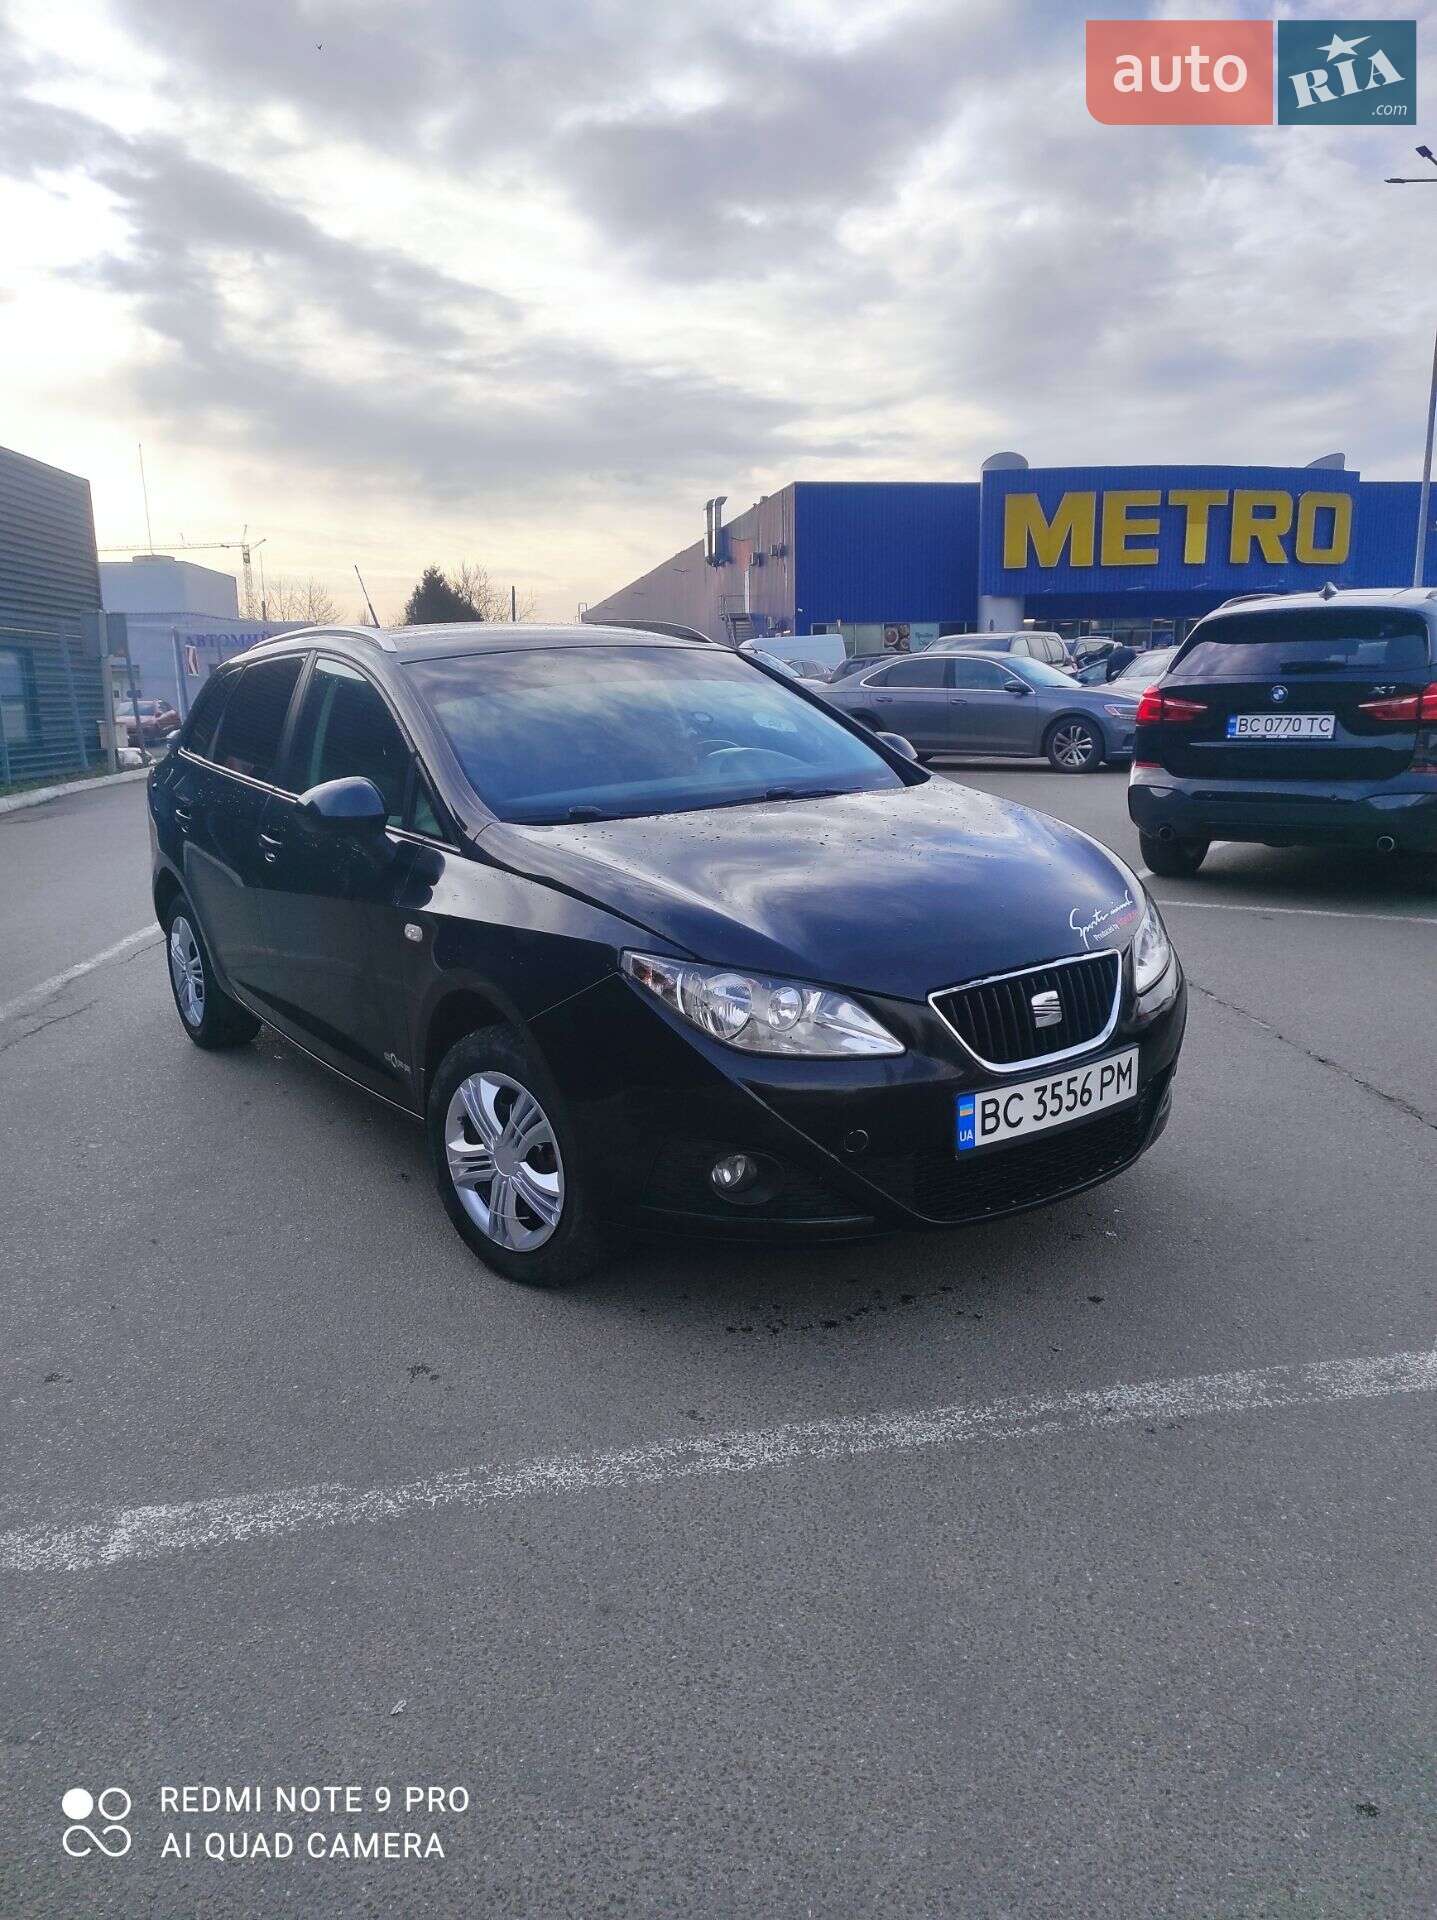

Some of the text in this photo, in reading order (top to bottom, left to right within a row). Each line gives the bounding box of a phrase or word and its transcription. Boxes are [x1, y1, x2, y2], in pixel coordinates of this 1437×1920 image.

[1003, 489, 1353, 569] METRO
[1238, 718, 1260, 733] BC
[1264, 718, 1302, 733] 0770
[1307, 717, 1331, 732] TC
[980, 1056, 1133, 1136] BC 3556 PM
[959, 1129, 974, 1142] UA
